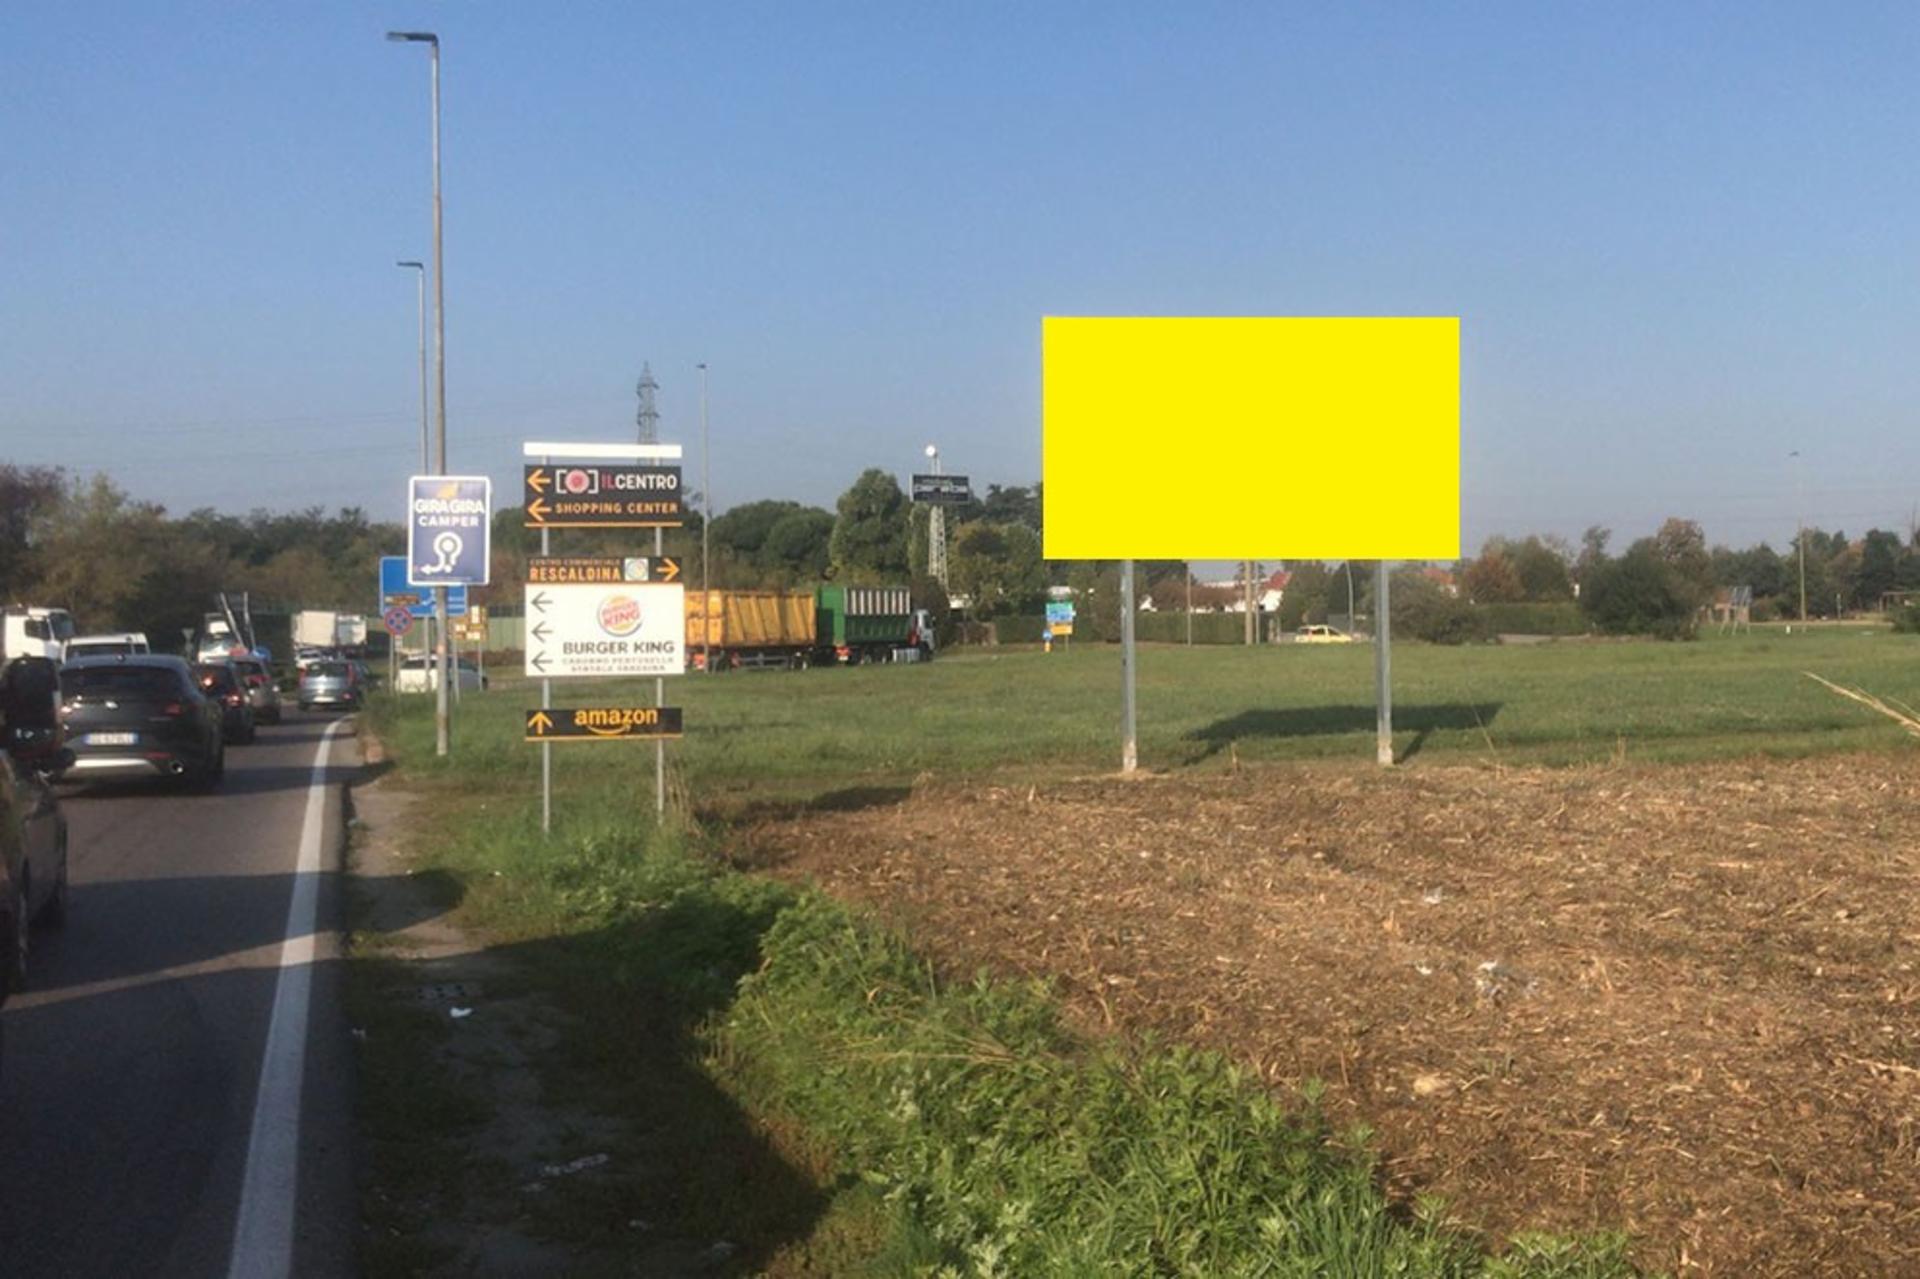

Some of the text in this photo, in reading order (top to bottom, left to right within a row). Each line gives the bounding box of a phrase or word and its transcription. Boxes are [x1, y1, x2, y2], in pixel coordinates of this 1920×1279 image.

[555, 502, 679, 514] SHOPPING CENTER
[418, 516, 479, 527] CAMPER
[529, 566, 621, 581] RESCALDINA
[562, 640, 675, 655] BURGER KING
[574, 709, 658, 725] amazon
